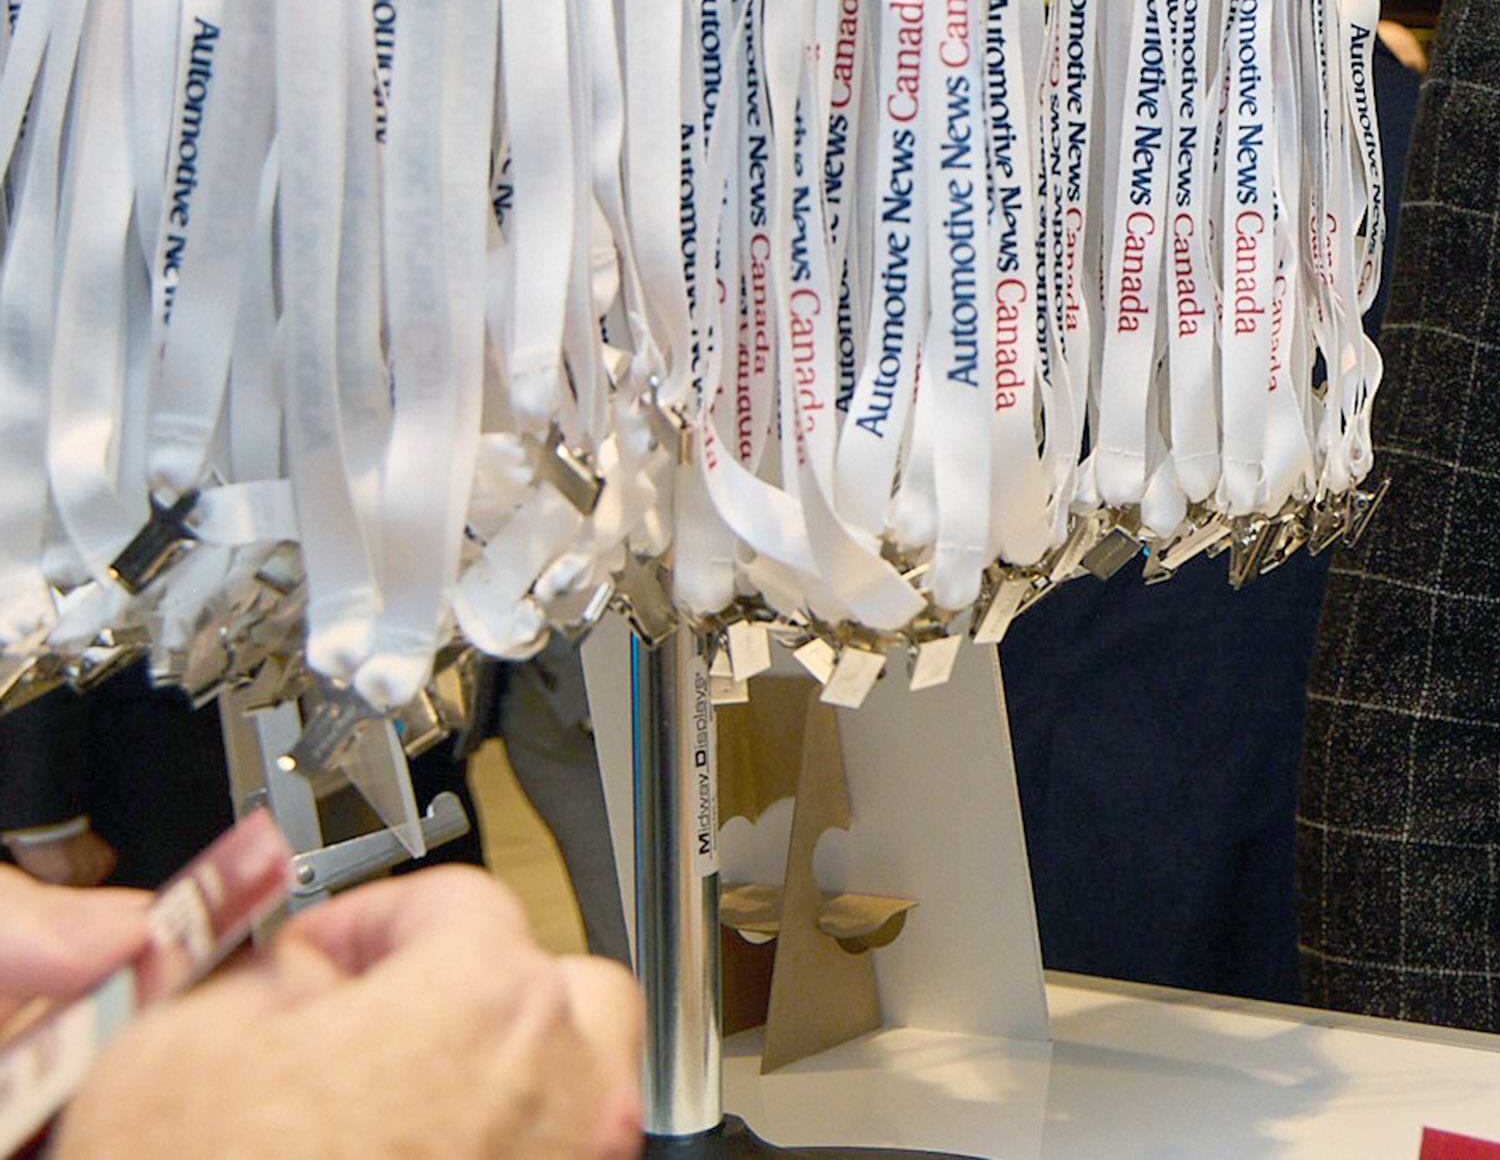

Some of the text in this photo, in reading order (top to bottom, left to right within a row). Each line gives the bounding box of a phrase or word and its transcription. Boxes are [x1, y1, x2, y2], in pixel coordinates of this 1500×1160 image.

[167, 15, 221, 228] Automotive
[940, 75, 972, 170] News
[1050, 93, 1061, 176] News
[1350, 23, 1379, 176] Automotive
[748, 135, 769, 228] News
[882, 128, 915, 224] News
[1066, 121, 1087, 202] News
[1130, 124, 1163, 206] News
[1176, 126, 1198, 207] News
[1236, 124, 1264, 206] News
[790, 186, 811, 283] News
[995, 187, 1021, 272] News
[1065, 206, 1083, 331] Canada
[1118, 211, 1156, 335] Canada
[1173, 213, 1206, 338] Canada
[1235, 211, 1265, 336] Canada
[750, 232, 771, 375] Canada
[855, 231, 911, 439] Automotive
[946, 179, 980, 388] Automotive
[1268, 274, 1287, 391] Canada
[995, 278, 1027, 412] Canada
[698, 773, 710, 854] Midway
